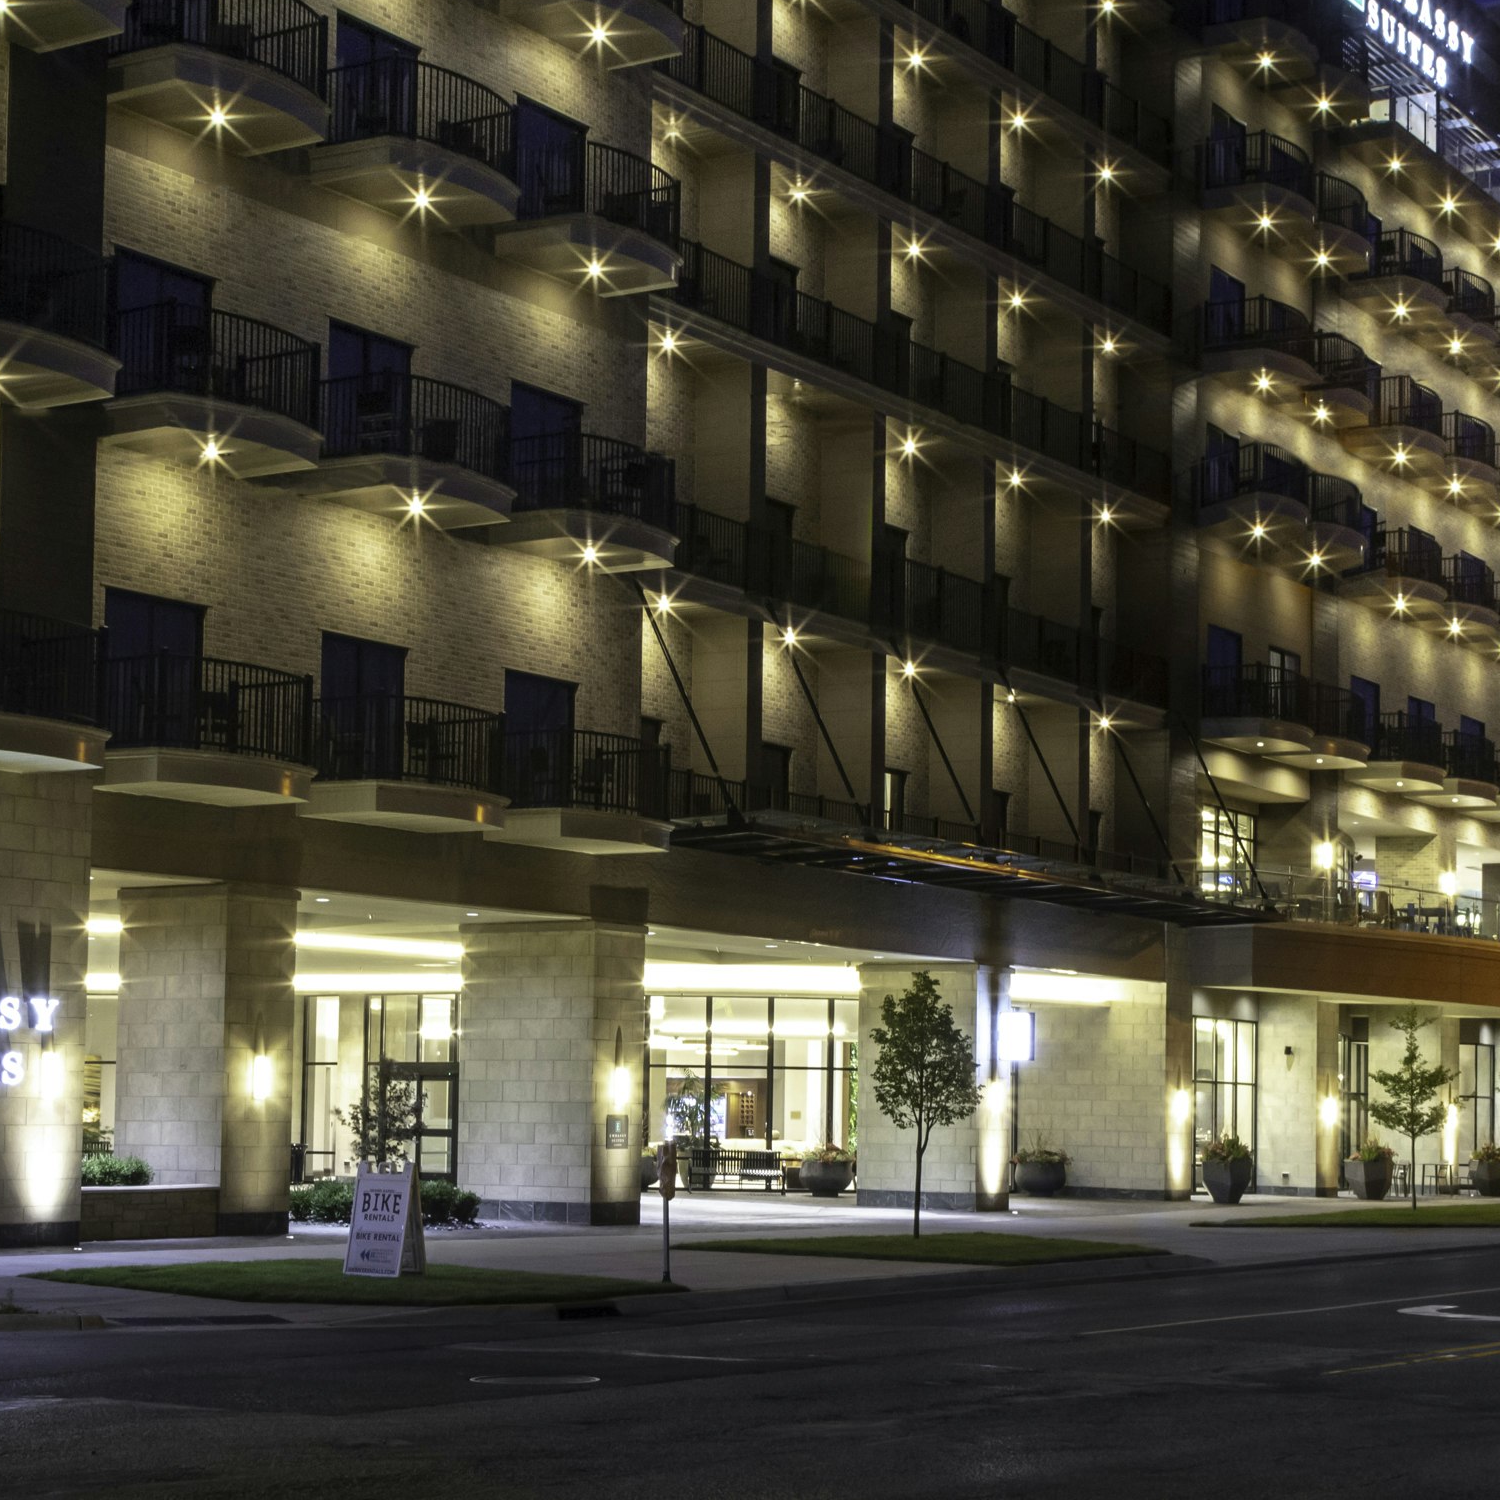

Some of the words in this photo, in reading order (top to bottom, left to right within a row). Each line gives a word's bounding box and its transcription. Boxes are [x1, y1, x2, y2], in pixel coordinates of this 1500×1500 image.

[362, 1192, 402, 1215] BIKE
[364, 1213, 395, 1222] RENTALS
[356, 1232, 371, 1240] BIKE
[373, 1233, 400, 1242] RENTAL
